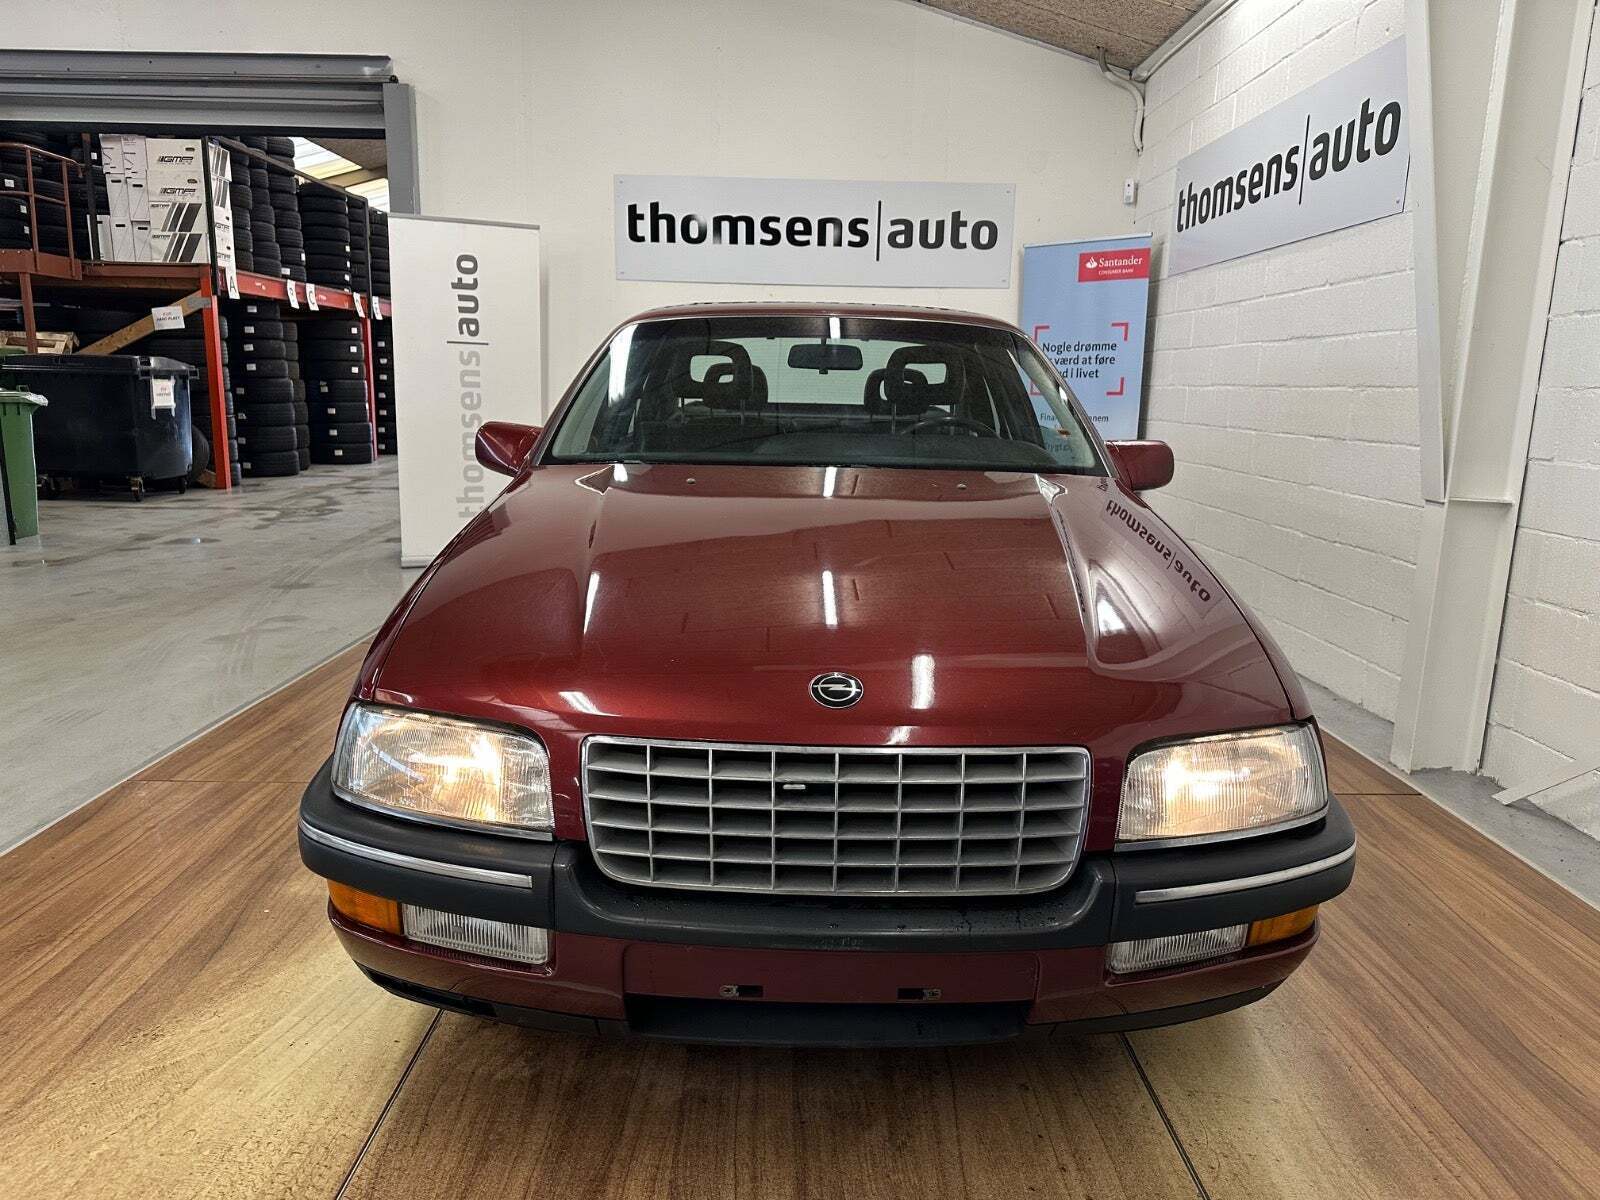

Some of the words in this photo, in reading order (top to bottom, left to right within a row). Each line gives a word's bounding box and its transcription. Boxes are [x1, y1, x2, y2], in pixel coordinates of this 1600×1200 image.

[1176, 145, 1300, 233] thomsens
[1309, 98, 1401, 181] auto
[627, 201, 869, 247] thomsens
[887, 210, 999, 250] auto
[1098, 255, 1143, 268] Santander
[450, 254, 480, 337] auto
[1042, 341, 1072, 355] Nogle
[1073, 341, 1117, 352] drømme
[1054, 355, 1079, 366] værd
[1081, 356, 1093, 365] at
[1095, 354, 1116, 365] føre
[1076, 367, 1100, 378] livet
